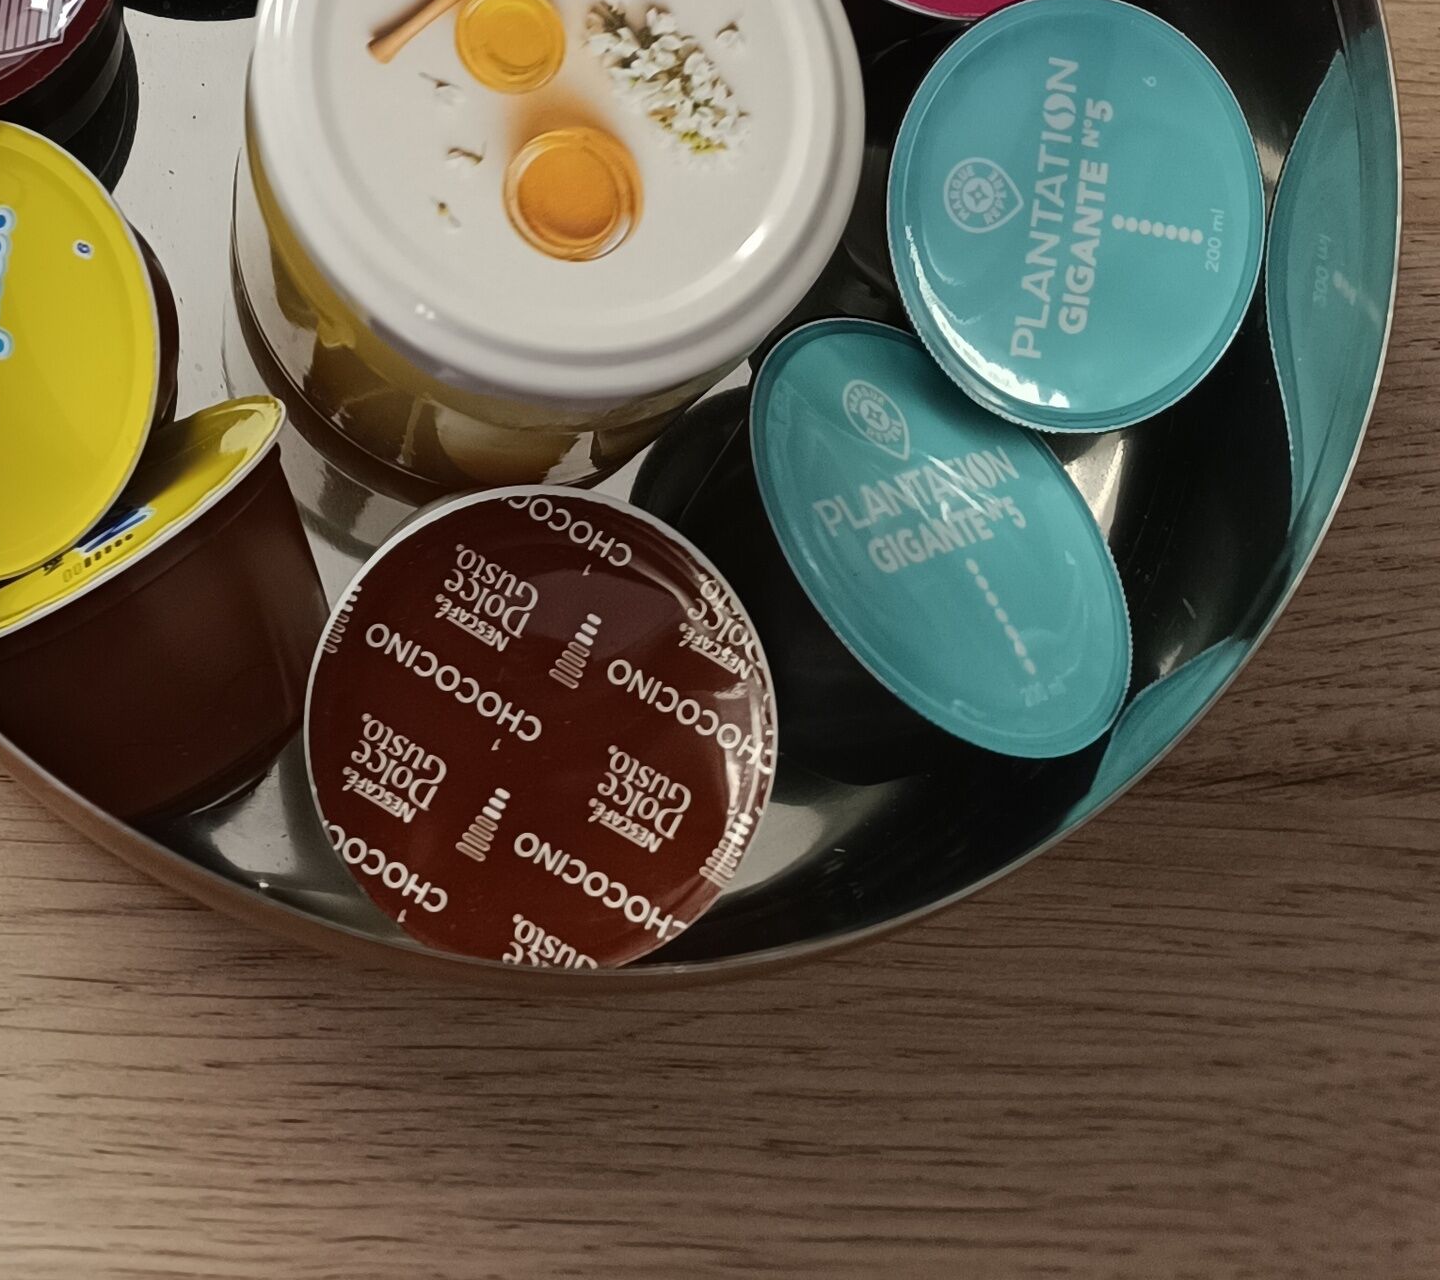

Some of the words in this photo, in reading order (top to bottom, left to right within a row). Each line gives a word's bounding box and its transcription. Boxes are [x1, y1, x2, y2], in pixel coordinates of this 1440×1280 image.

[1010, 56, 1079, 359] PLANTATION
[1207, 208, 1225, 232] ml
[1059, 159, 1109, 334] GIGANTE
[1205, 236, 1223, 273] 200
[811, 445, 1020, 536] PLANTATION
[501, 495, 633, 567] CHOCOC
[867, 504, 994, 574] GIGANTE
[443, 568, 531, 639] Dolce
[457, 545, 539, 614] Gusto
[435, 593, 510, 652] NESCAFÉ
[678, 622, 754, 681] NESCAFÉ
[366, 623, 543, 742] CHOCOCINO
[351, 740, 439, 812] Dolce
[362, 715, 448, 787] Gusto
[608, 746, 692, 818] Gusto
[343, 765, 417, 823] NESCAFÉ
[588, 798, 663, 853] NESCAFÉ
[597, 772, 684, 841] Dolce
[322, 819, 448, 913] CHOCOC
